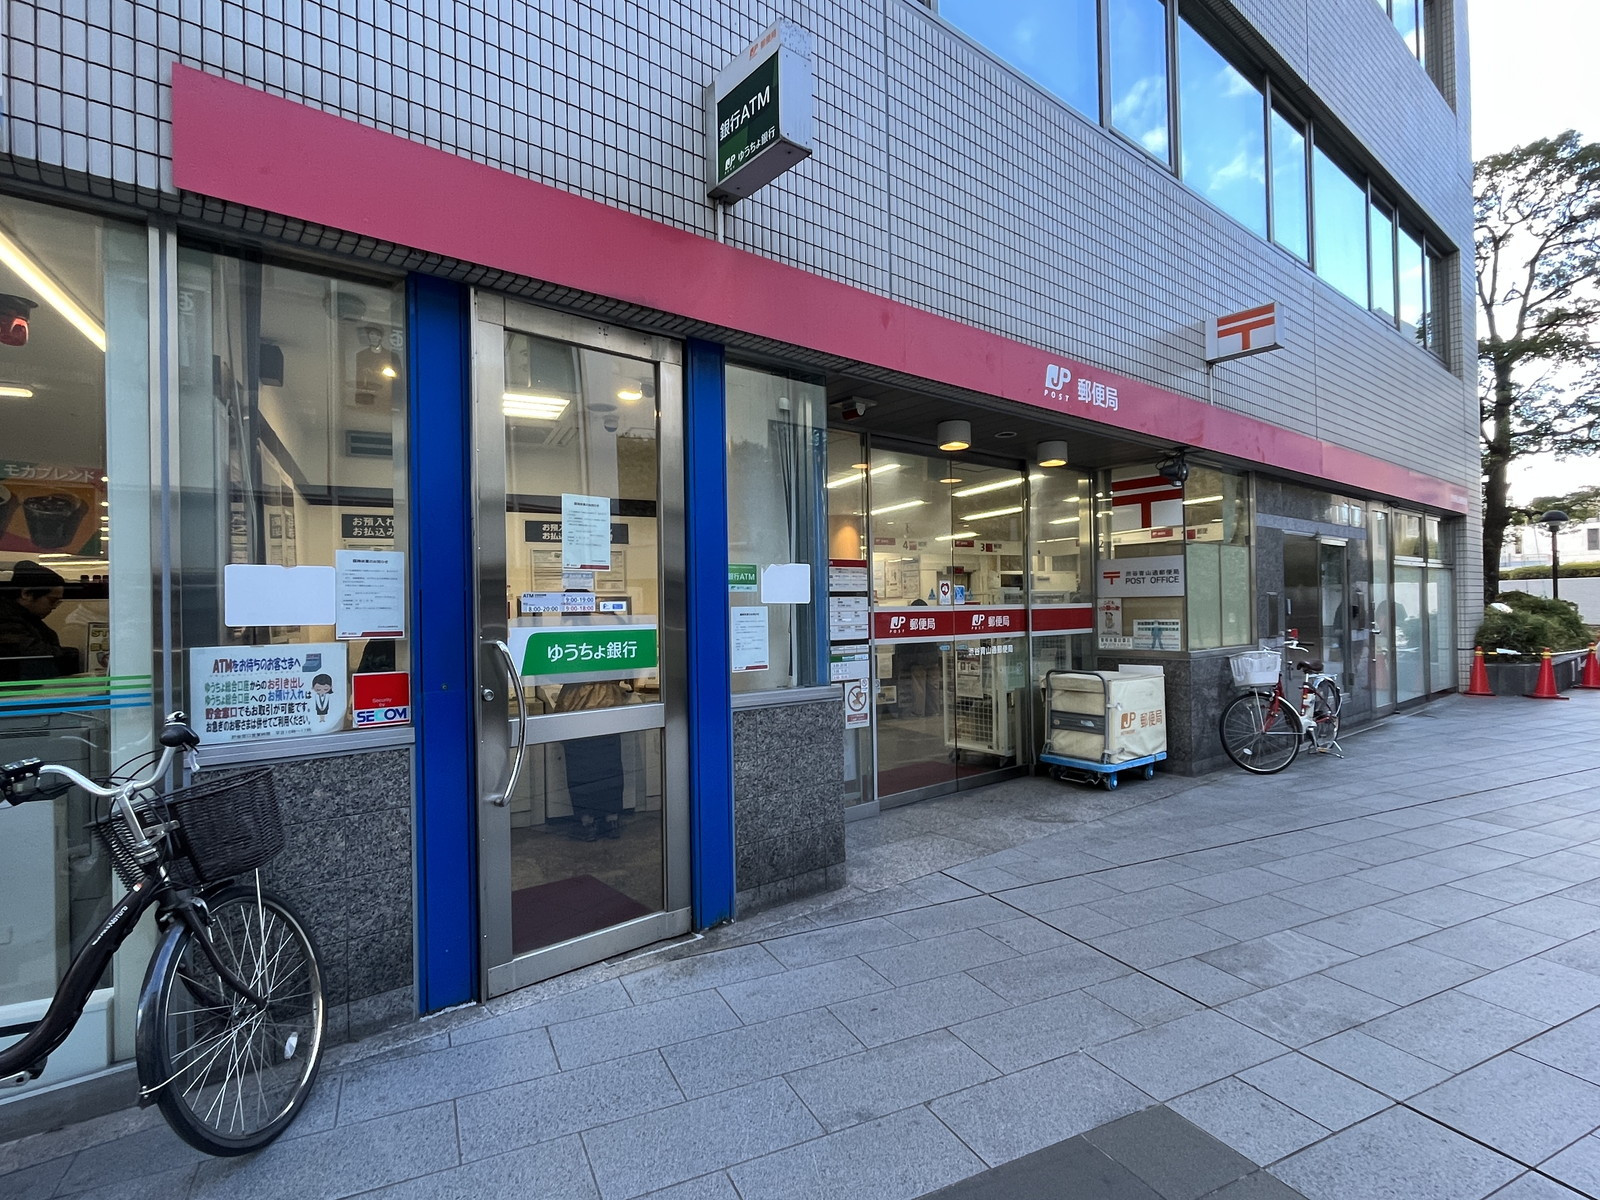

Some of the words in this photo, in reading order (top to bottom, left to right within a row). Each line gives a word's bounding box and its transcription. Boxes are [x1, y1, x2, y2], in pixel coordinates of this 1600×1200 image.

[719, 85, 770, 141] 銀行ATM
[737, 125, 776, 163] ゆうちょ銀行
[1044, 389, 1070, 402] POST
[1045, 364, 1072, 390] JP
[1077, 378, 1119, 411] 郵便局
[3, 463, 95, 483] モカブレンド
[902, 540, 908, 550] 4
[980, 543, 985, 552] 3
[1125, 576, 1145, 585] POST
[1150, 575, 1180, 584] OFFICE
[909, 617, 936, 631] 郵便局
[987, 615, 1010, 628] 郵便局
[547, 640, 638, 663] ゆうちょ銀行
[212, 656, 301, 674] ATMをお待ちのお客さまへ
[356, 707, 407, 723] SECOM
[1140, 709, 1163, 729] 郵便局
